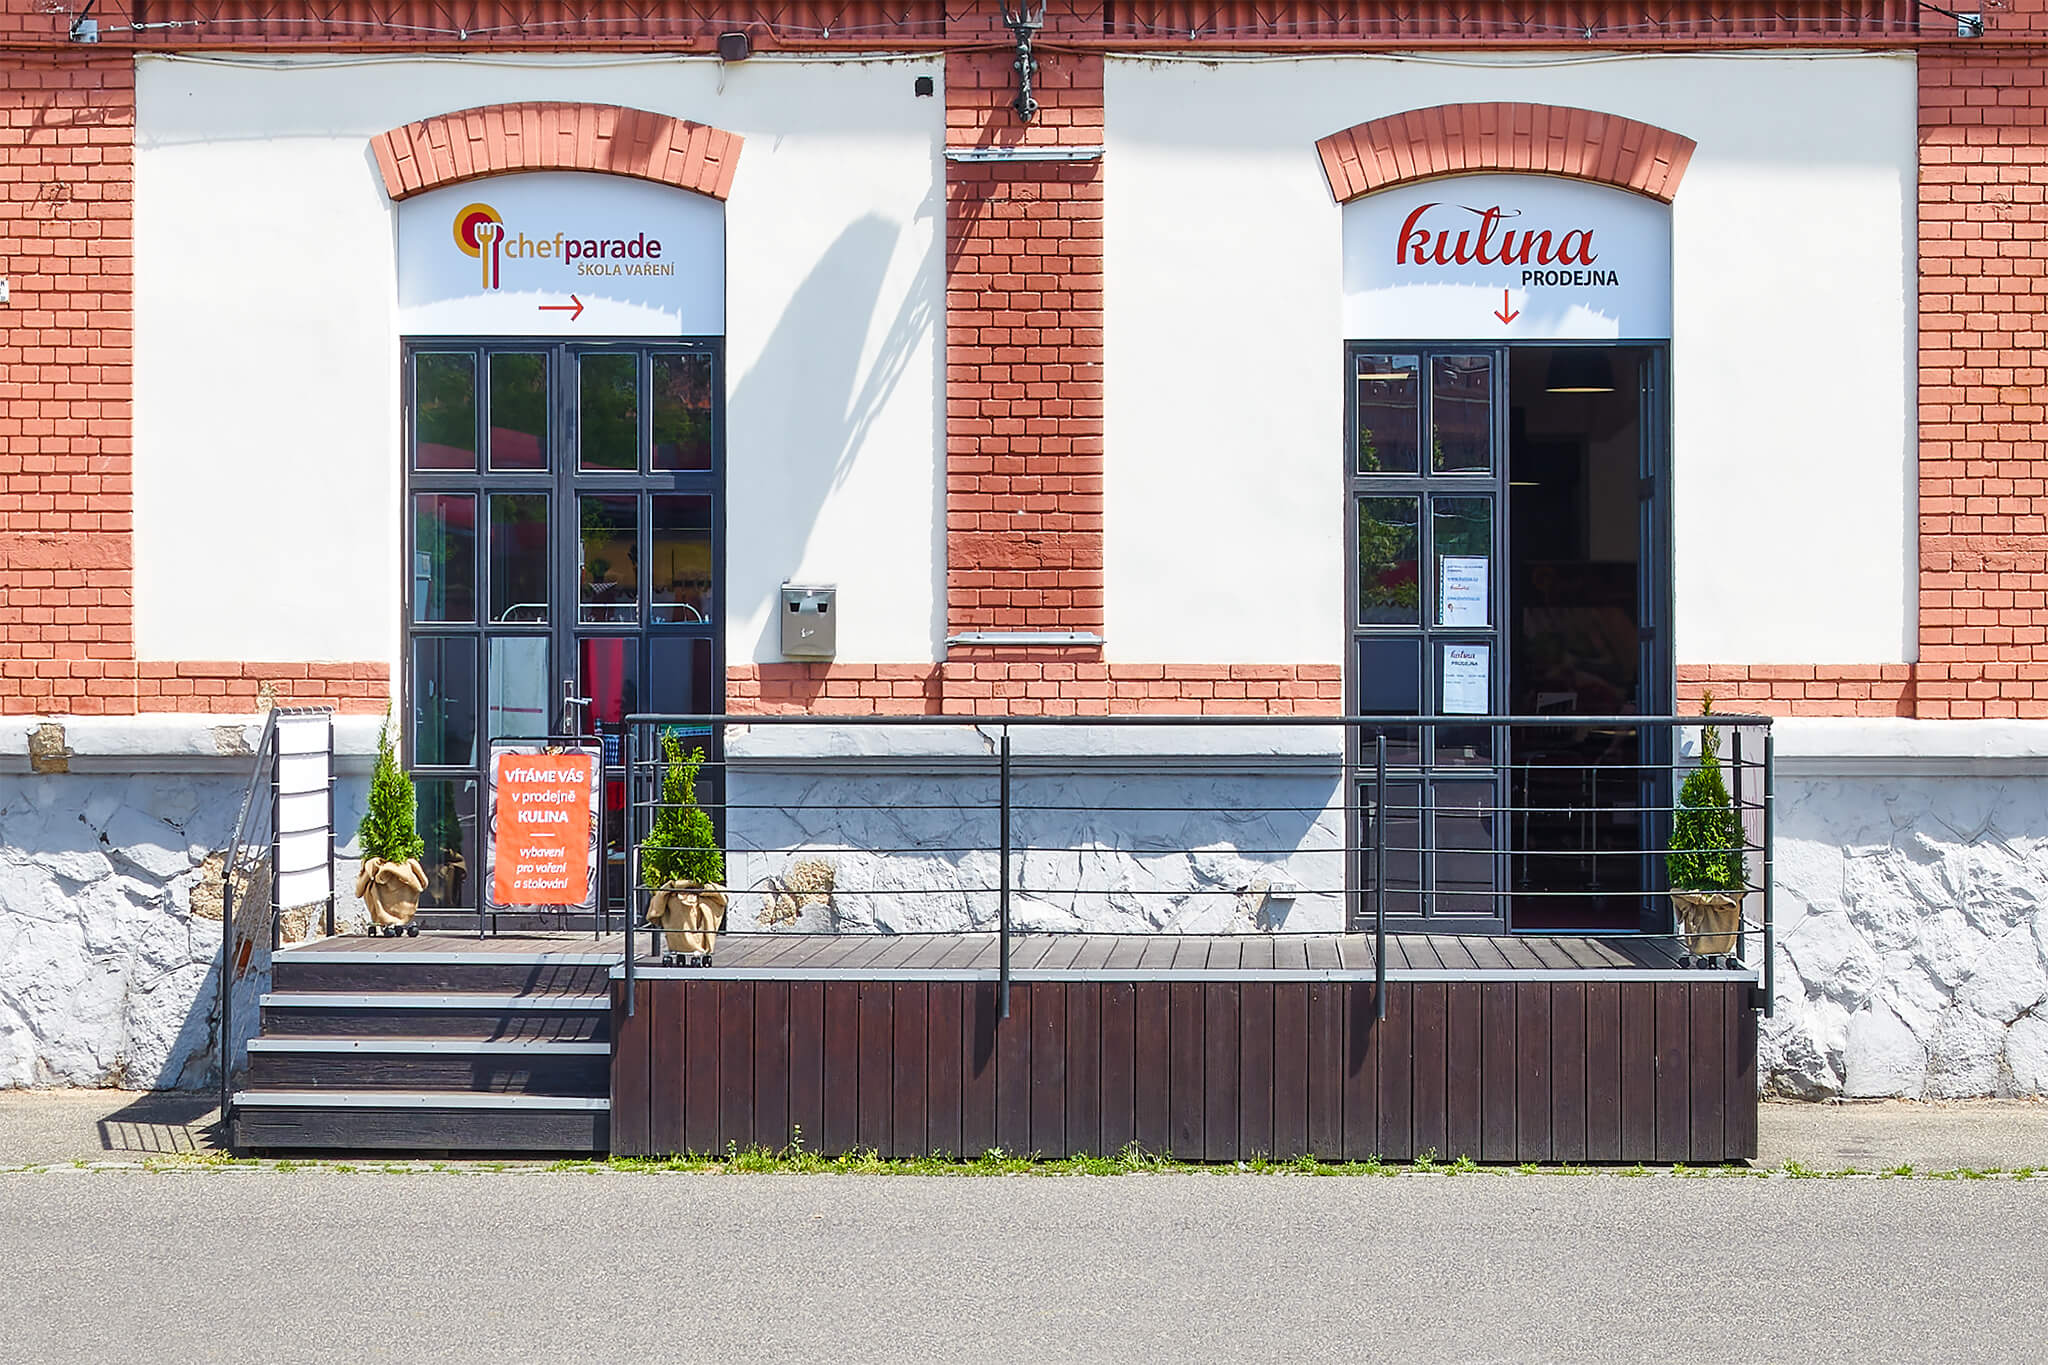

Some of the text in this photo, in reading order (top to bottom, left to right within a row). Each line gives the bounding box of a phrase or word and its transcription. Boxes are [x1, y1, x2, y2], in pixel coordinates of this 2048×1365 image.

[577, 262, 675, 276] ŠKOLA VAŘENÍ
[1522, 270, 1619, 286] PRODEJNA
[504, 768, 584, 783] VÍTÁME VÁS
[512, 789, 576, 804] v prodejně
[518, 810, 569, 823] KULINA
[519, 847, 565, 859] vybavení
[516, 862, 566, 876] pro vaření
[523, 877, 568, 889] stolování
